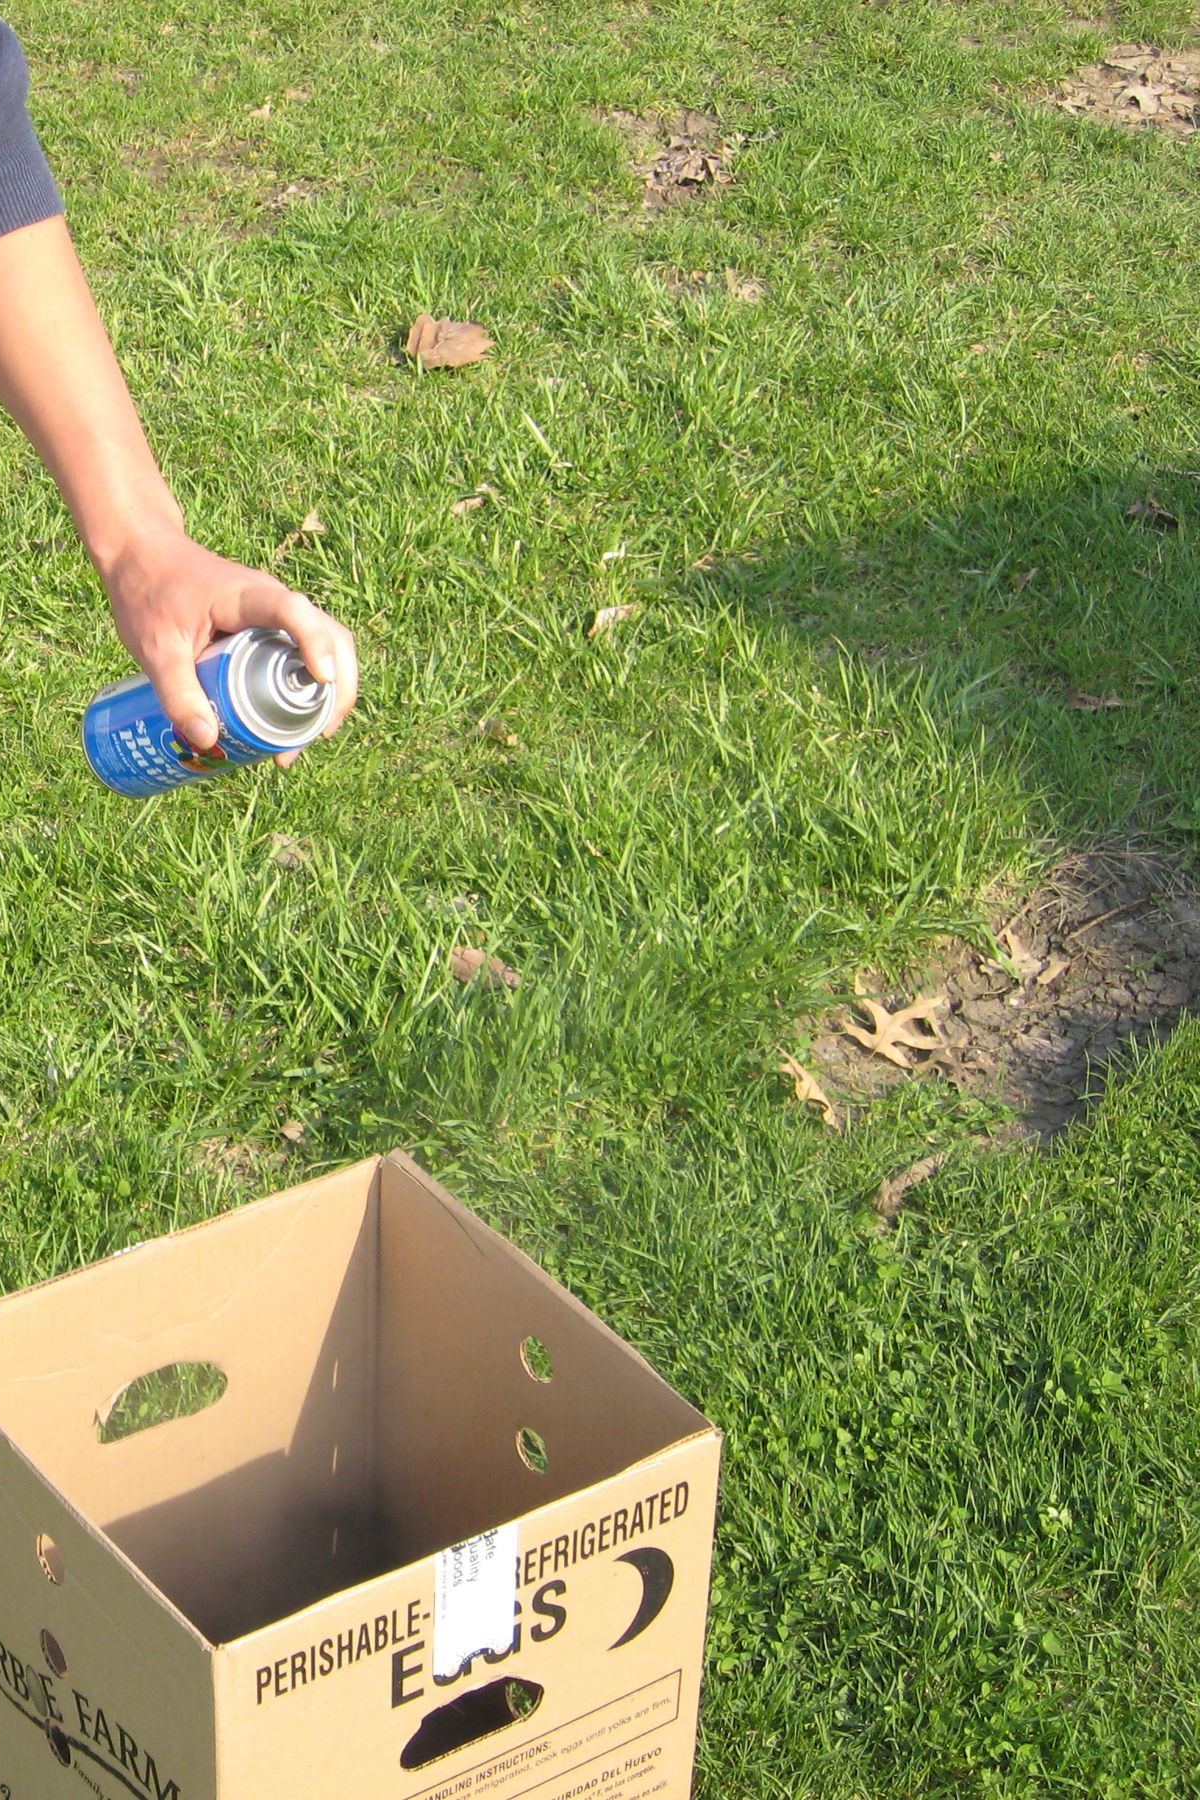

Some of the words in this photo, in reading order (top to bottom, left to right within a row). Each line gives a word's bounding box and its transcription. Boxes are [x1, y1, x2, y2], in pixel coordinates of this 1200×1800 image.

[118, 727, 178, 785] pain
[256, 1599, 431, 1705] PERISHABLE-
[391, 1578, 567, 1710] ES
[475, 1740, 552, 1783] INSTRUCTIONS:
[535, 1750, 558, 1767] cook
[560, 1740, 583, 1755] eggs
[586, 1727, 606, 1742] until
[608, 1716, 631, 1733] yolks
[634, 1707, 649, 1720] are
[552, 1778, 599, 1800] URIDAD
